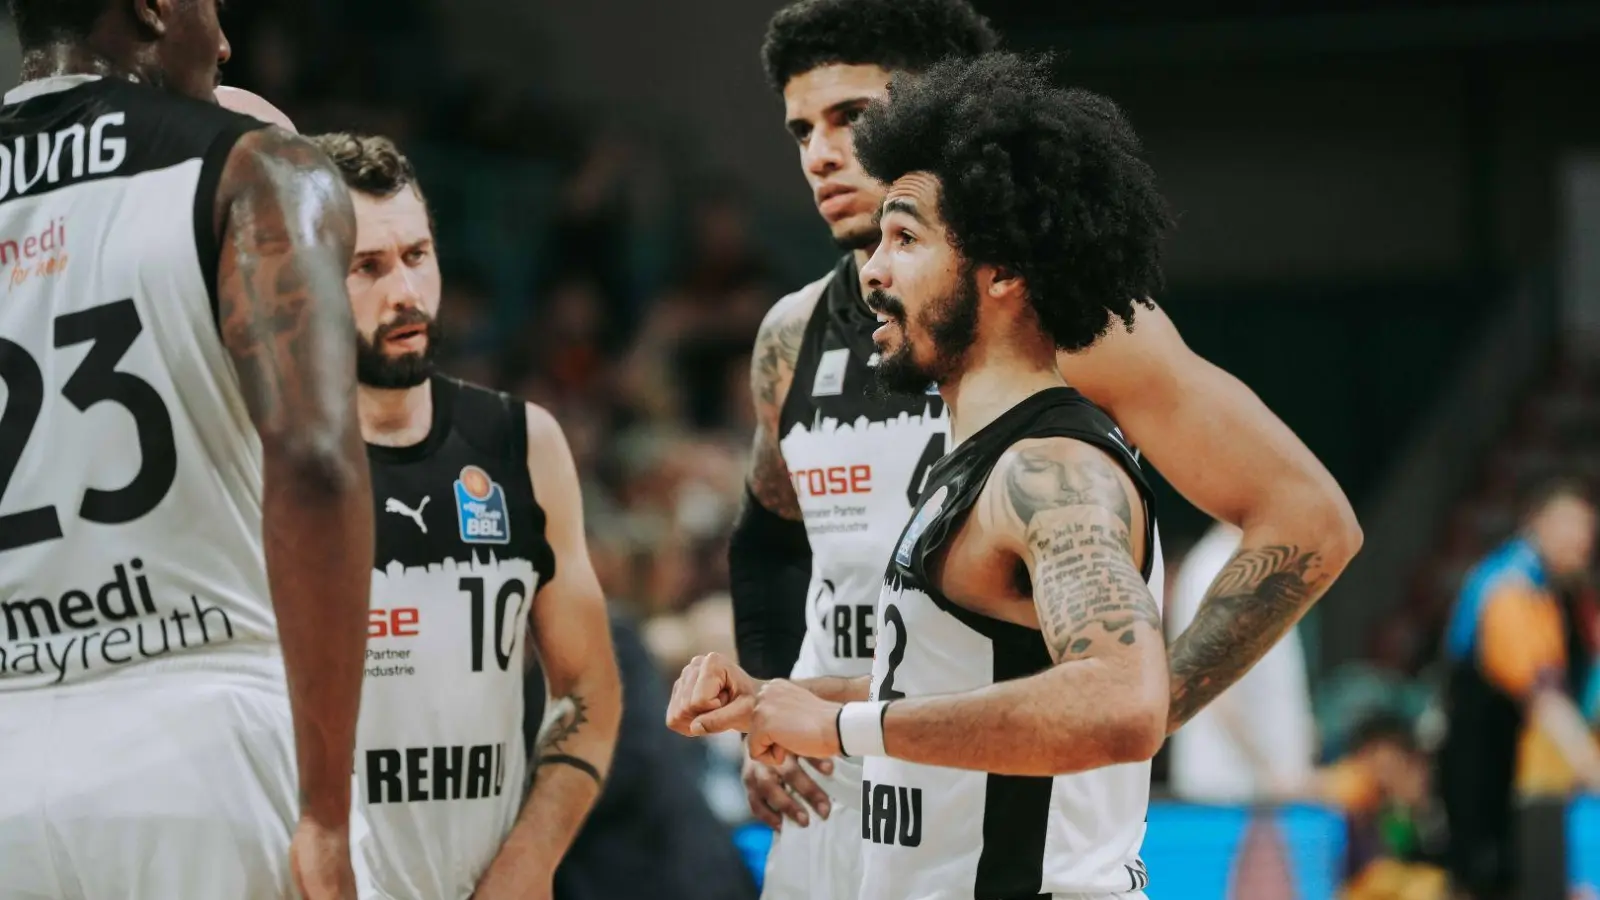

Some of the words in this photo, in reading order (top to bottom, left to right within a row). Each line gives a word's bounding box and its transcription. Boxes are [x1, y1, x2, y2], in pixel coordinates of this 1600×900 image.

[790, 465, 872, 496] rose
[2, 558, 157, 642] medi
[458, 577, 525, 673] 10
[366, 650, 411, 660] Partner
